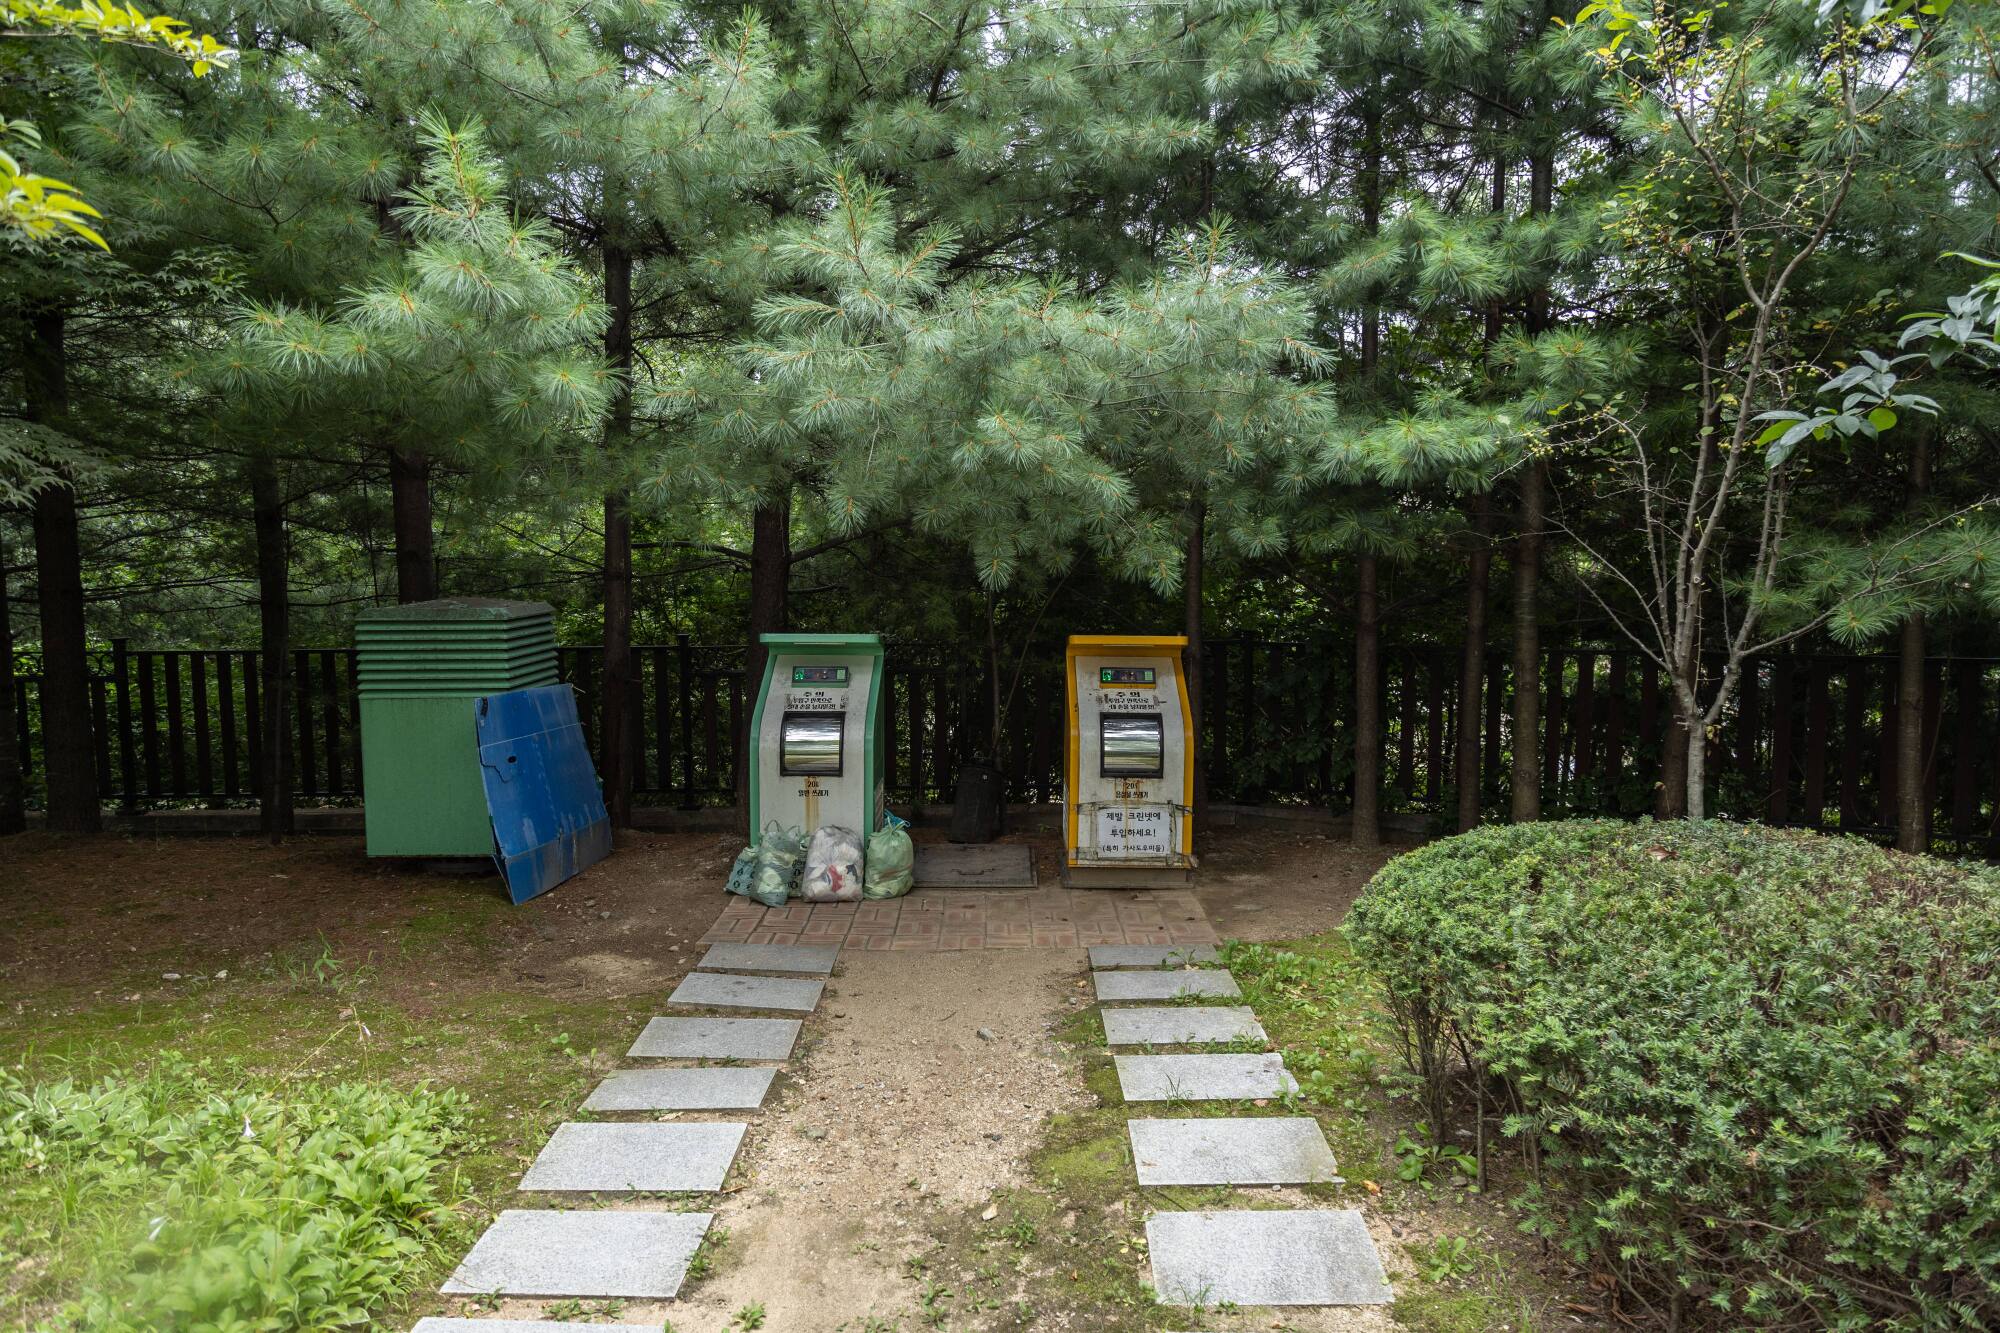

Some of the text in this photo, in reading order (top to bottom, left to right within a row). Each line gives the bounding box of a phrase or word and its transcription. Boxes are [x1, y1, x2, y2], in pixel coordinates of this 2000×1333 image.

[812, 790, 829, 798] 쓰레기
[1106, 812, 1161, 822] 제발 크린넷에
[1109, 829, 1156, 838] 투입하세요!
[1102, 844, 1165, 853] (특히 가사도우미들)
